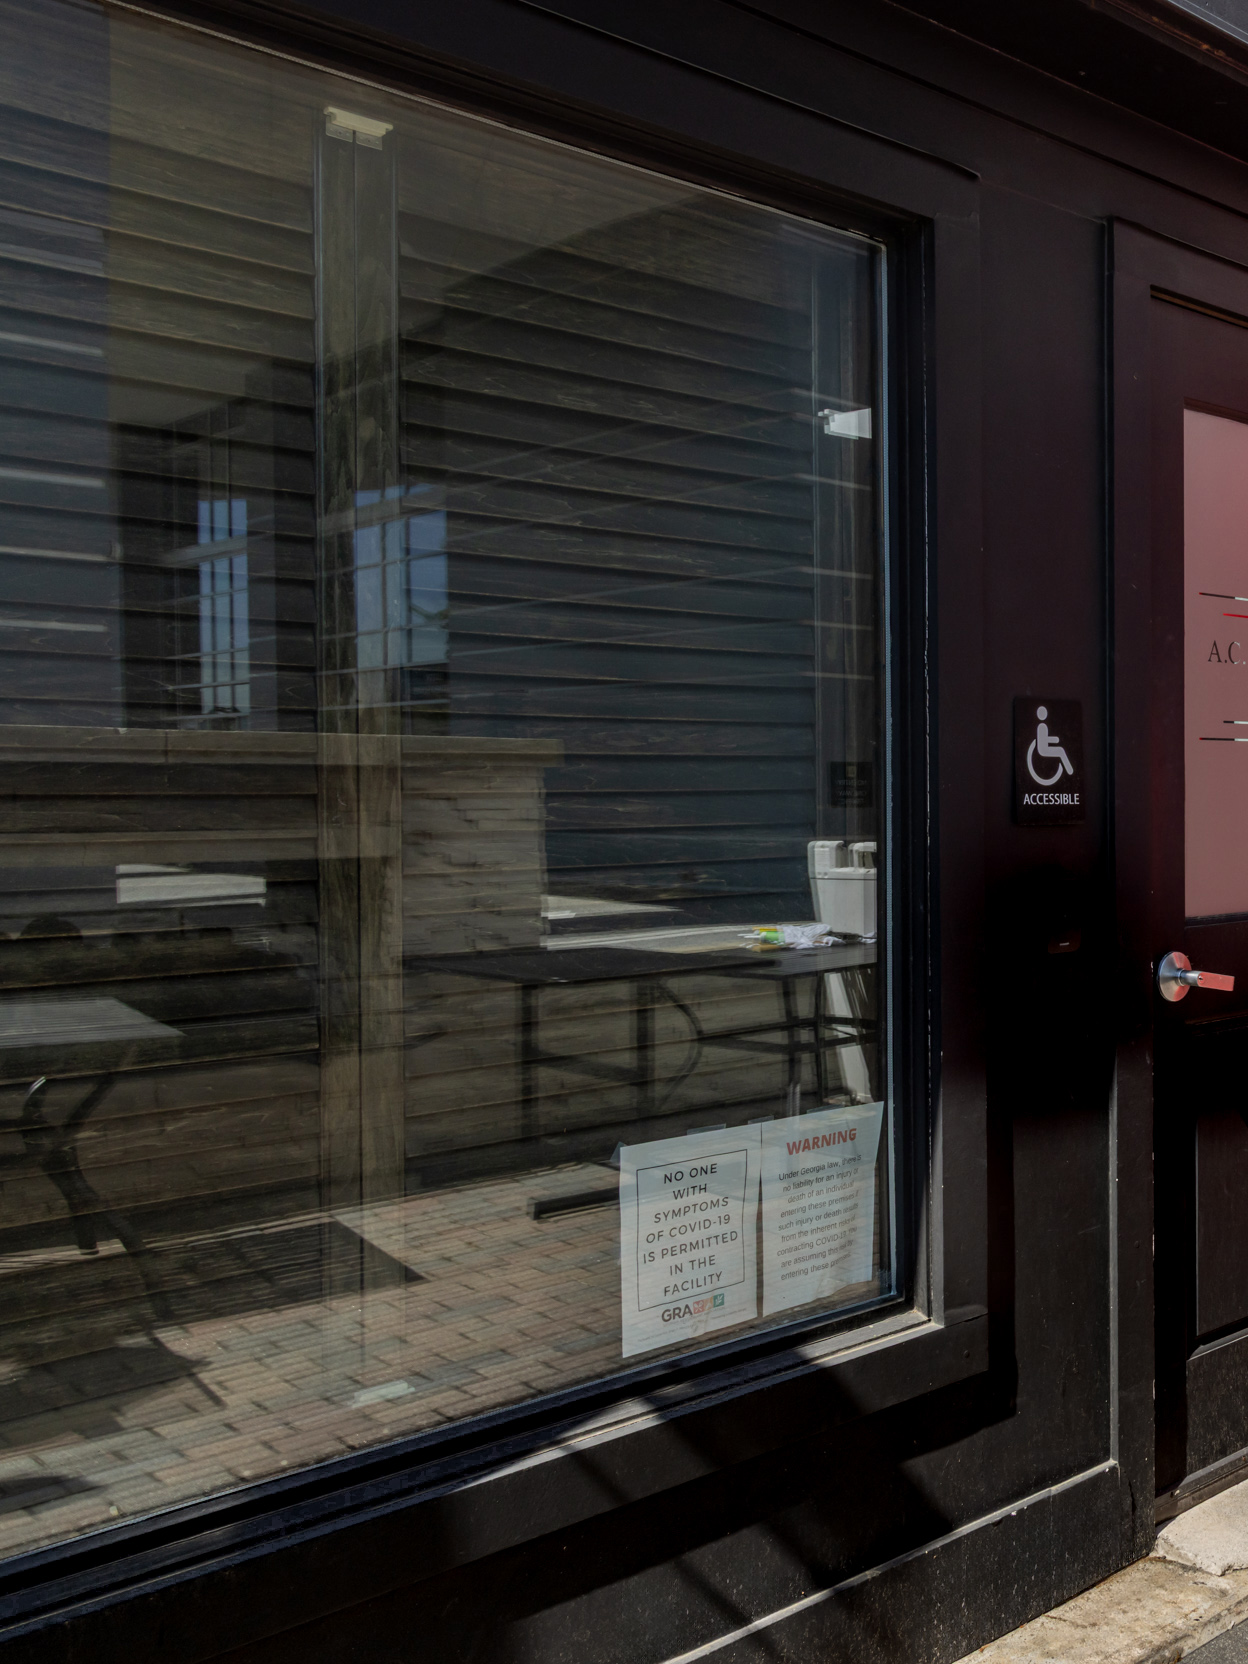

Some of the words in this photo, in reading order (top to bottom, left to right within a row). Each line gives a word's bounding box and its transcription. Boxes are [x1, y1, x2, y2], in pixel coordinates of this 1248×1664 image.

[1207, 640, 1246, 665] A.C.
[1023, 793, 1080, 805] ACCESSIBLE
[786, 1128, 857, 1156] WARNING
[663, 1170, 684, 1184] NO
[689, 1163, 718, 1178] ONE
[778, 1169, 799, 1181] Under
[800, 1163, 826, 1176] Georgia
[827, 1160, 841, 1168] law,
[842, 1156, 856, 1166] there
[672, 1183, 707, 1200] WITH
[782, 1185, 791, 1193] no
[792, 1178, 814, 1190] liability
[815, 1175, 824, 1184] for
[825, 1173, 835, 1182] an
[836, 1169, 852, 1180] injury
[787, 1192, 806, 1204] death
[807, 1189, 815, 1199] of
[815, 1188, 825, 1197] an
[825, 1180, 855, 1194] individual
[653, 1196, 729, 1224] SYMPTOMS
[780, 1204, 807, 1218] entering
[808, 1200, 827, 1211] these
[828, 1193, 855, 1207] premises
[645, 1230, 664, 1244] OF
[669, 1214, 731, 1238] COVID-19
[778, 1220, 794, 1231] such
[795, 1216, 814, 1227] injury
[814, 1213, 823, 1222] or
[823, 1208, 842, 1220] death
[781, 1232, 797, 1243] from
[797, 1229, 809, 1238] the
[810, 1222, 837, 1235] inherent
[643, 1251, 656, 1264] IS
[661, 1230, 738, 1259] PERMITTED
[776, 1241, 814, 1257] contracting
[780, 1260, 792, 1268] are
[793, 1250, 827, 1265] assuming
[827, 1247, 839, 1256] this
[669, 1262, 683, 1276] IN
[688, 1254, 716, 1271] THE
[780, 1267, 809, 1281] entering
[810, 1262, 830, 1273] these
[663, 1270, 723, 1297] FACILITY
[661, 1303, 693, 1323] GRA
